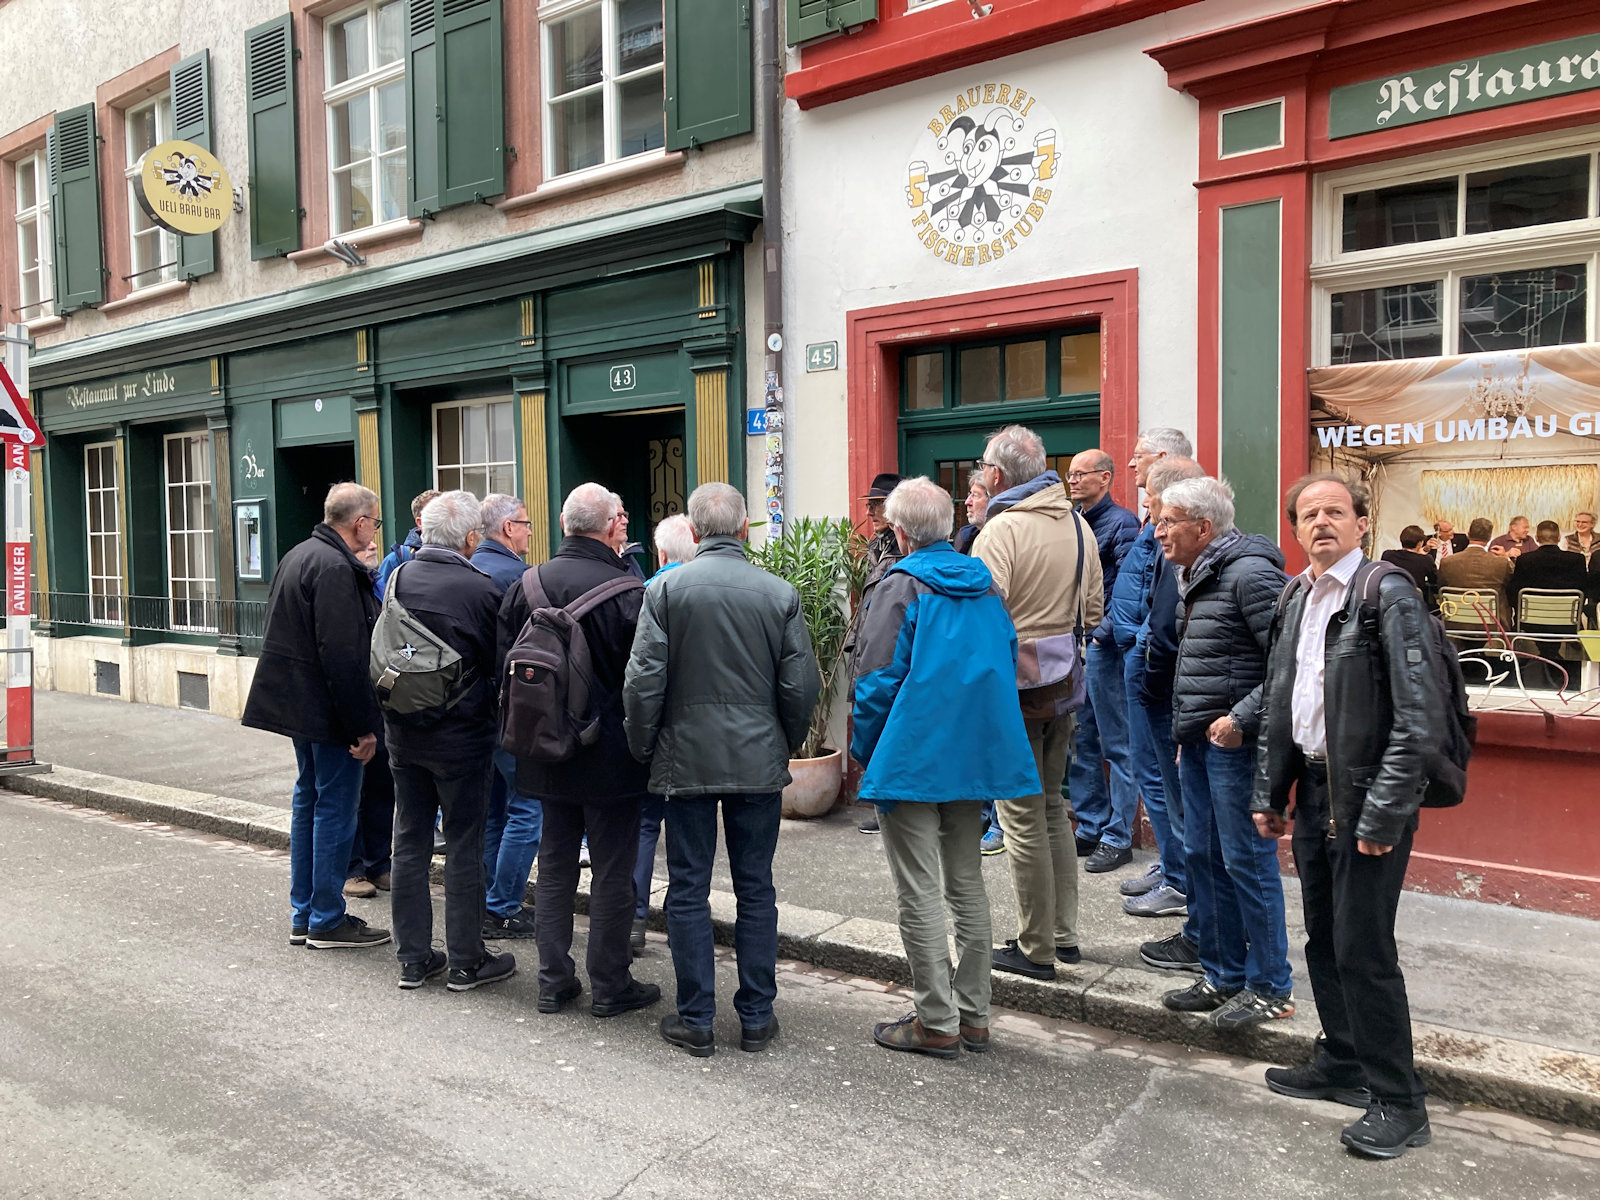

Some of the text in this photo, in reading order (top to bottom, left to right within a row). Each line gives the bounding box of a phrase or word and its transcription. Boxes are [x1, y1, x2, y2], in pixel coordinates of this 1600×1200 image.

[927, 83, 1036, 138] BRAUEREI
[159, 199, 177, 213] UELI
[204, 207, 221, 220] BAR
[911, 186, 1052, 266] FISCHERSTUBE
[811, 347, 832, 365] 45
[66, 371, 175, 410] Restaurant zur Linde
[613, 369, 631, 386] 43
[1317, 422, 1424, 448] WEGEN
[1434, 414, 1557, 442] UMBAU
[241, 454, 265, 479] Bar
[13, 546, 25, 611] ANLIKER
